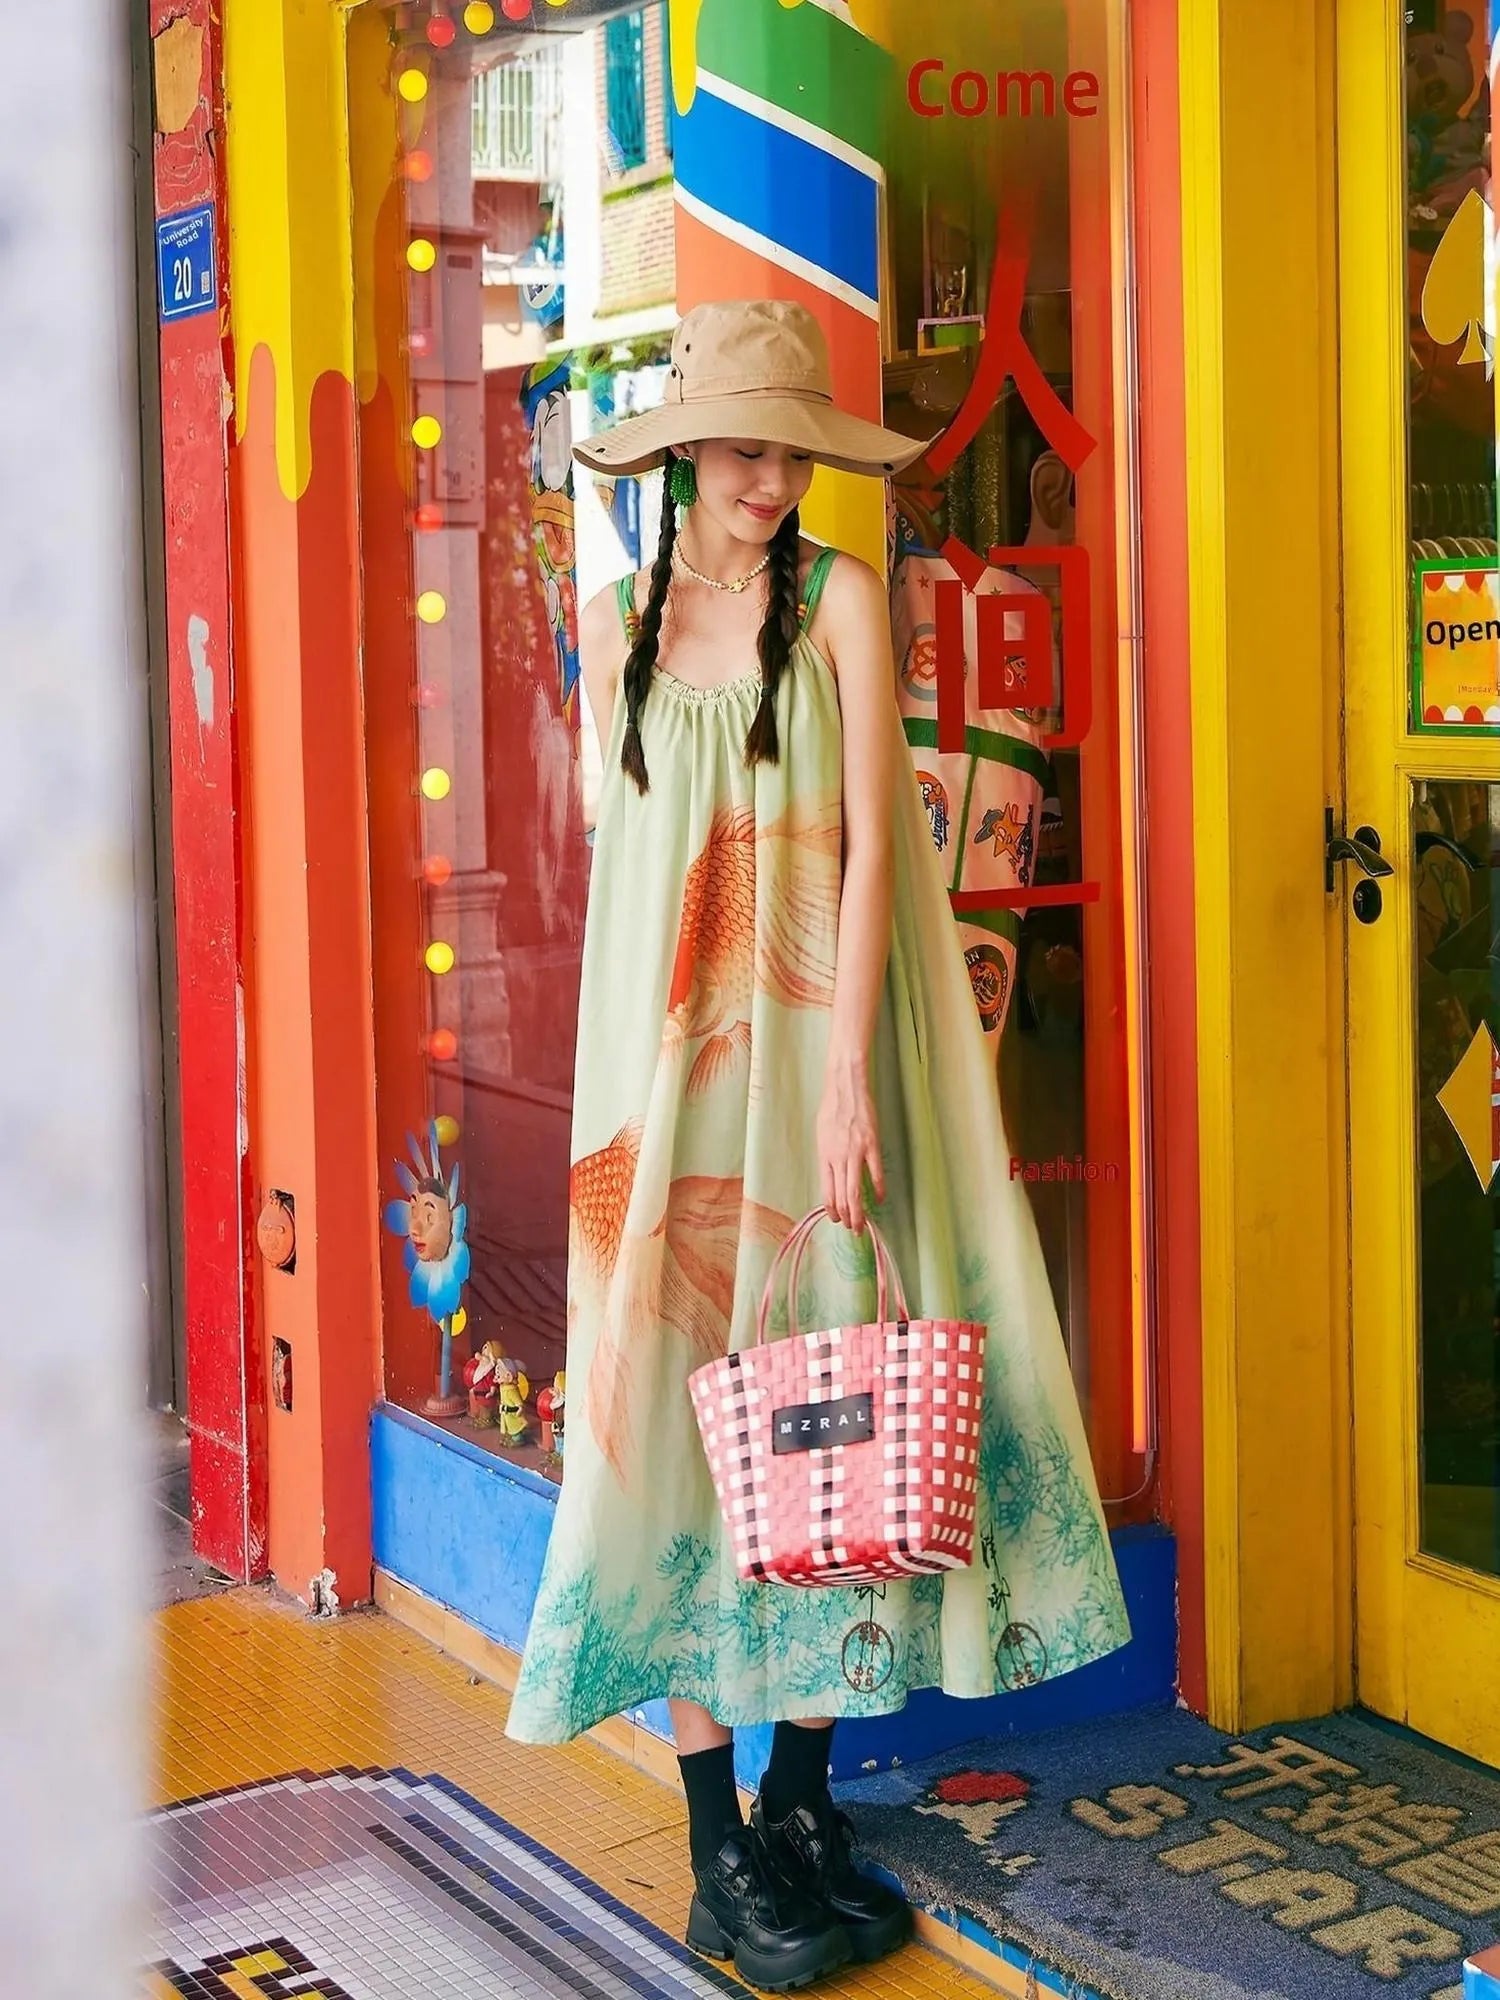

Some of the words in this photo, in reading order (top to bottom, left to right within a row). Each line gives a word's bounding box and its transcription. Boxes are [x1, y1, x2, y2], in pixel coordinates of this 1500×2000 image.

[907, 58, 1099, 117] Come
[162, 218, 203, 245] University
[176, 231, 199, 248] Road
[173, 256, 192, 301] 20
[1426, 620, 1500, 650] Open
[1008, 1155, 1119, 1182] Fashion
[780, 1410, 866, 1434] MZRAL
[1071, 1783, 1463, 2000] STAR
